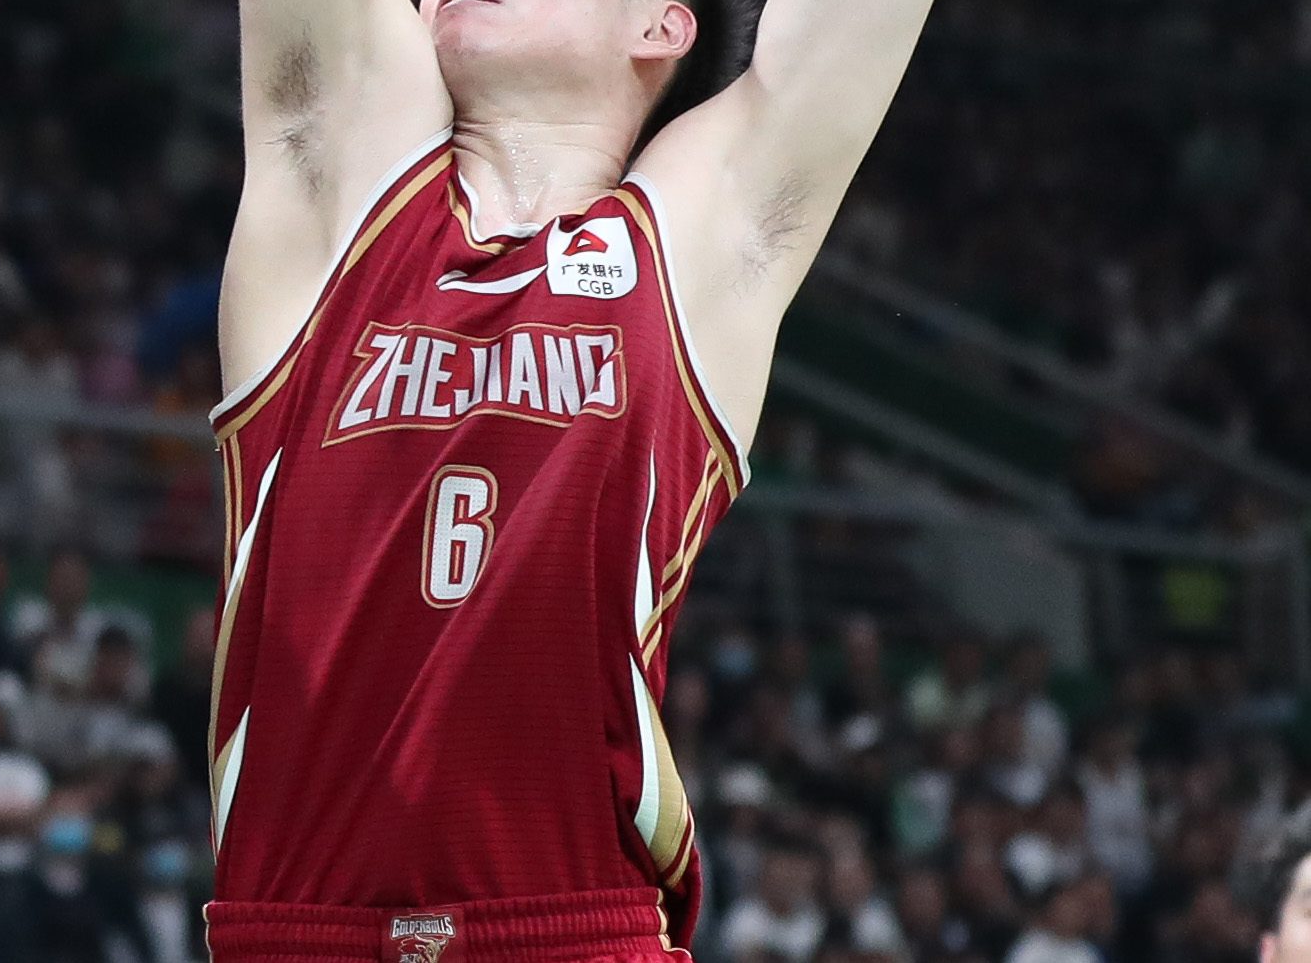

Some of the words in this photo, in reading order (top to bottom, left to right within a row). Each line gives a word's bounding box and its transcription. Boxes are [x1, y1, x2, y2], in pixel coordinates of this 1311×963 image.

[561, 262, 623, 278] 广发银行
[577, 278, 614, 295] CGB
[337, 332, 616, 430] ZHEJIANG
[425, 470, 494, 605] 6
